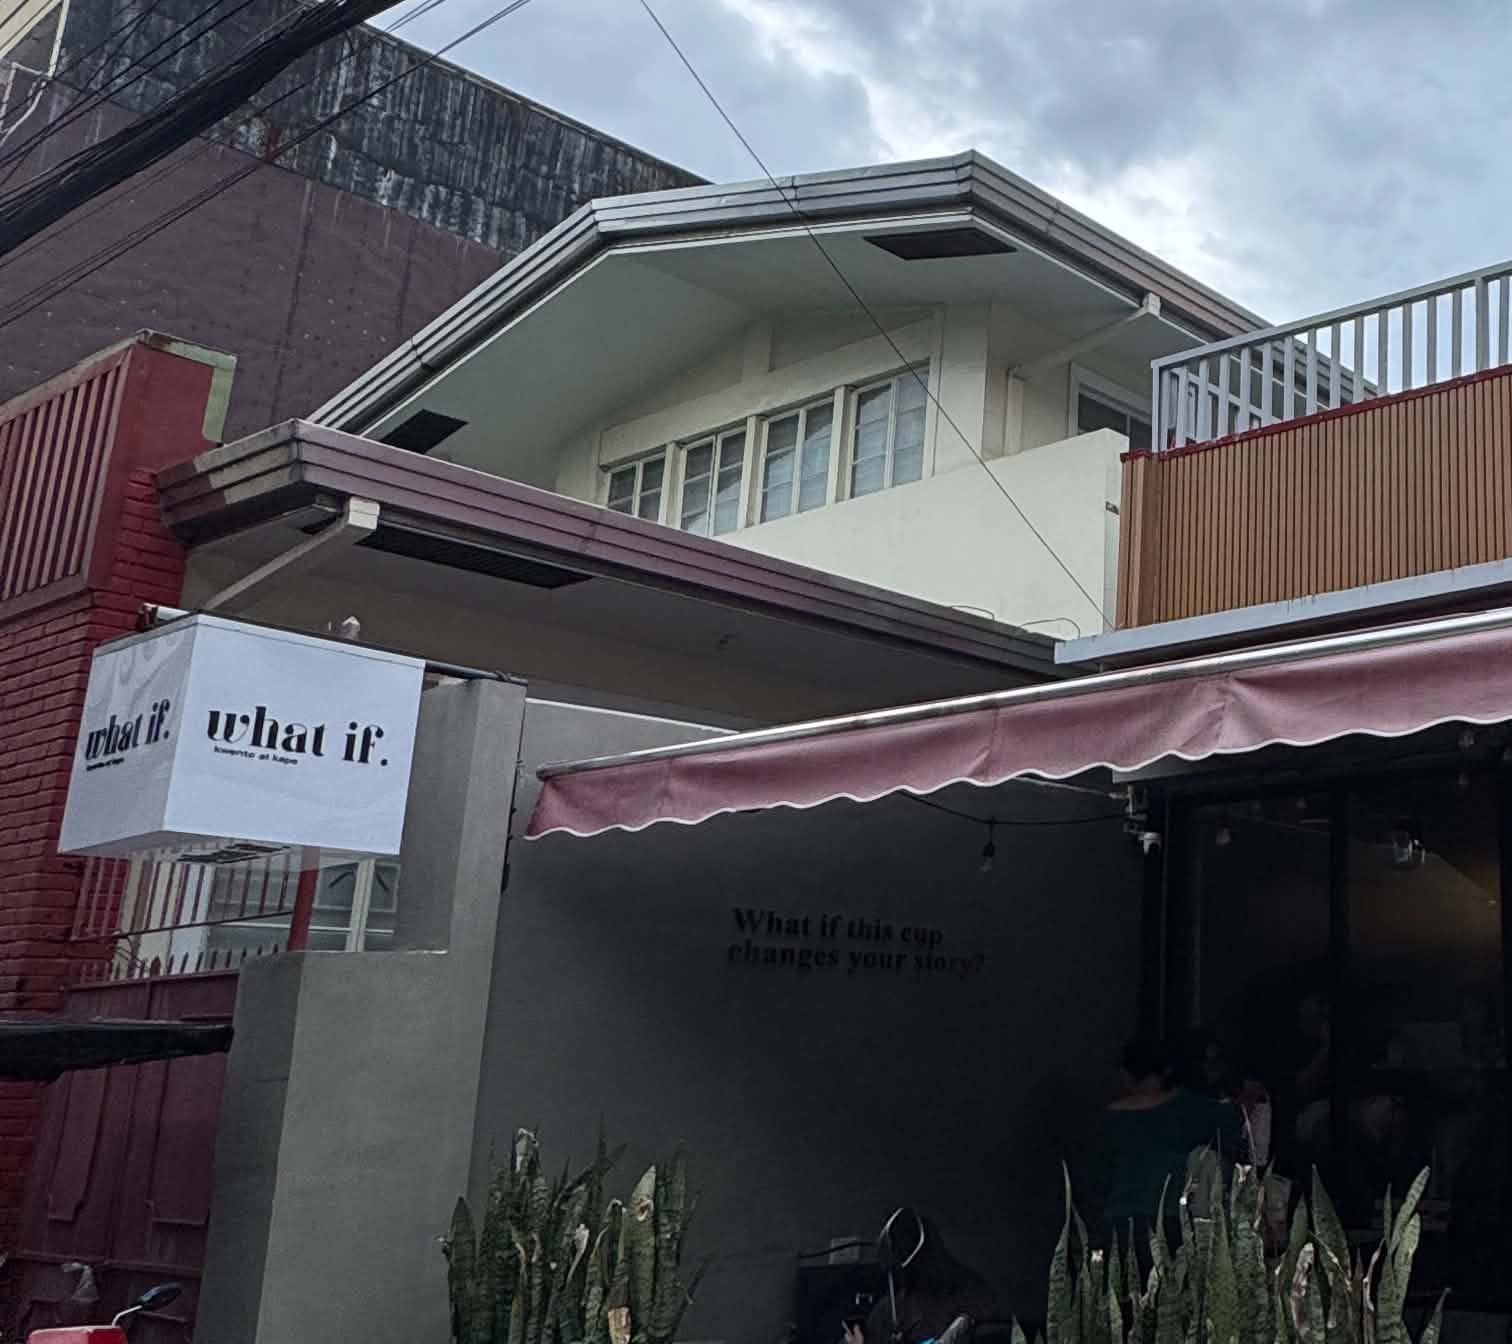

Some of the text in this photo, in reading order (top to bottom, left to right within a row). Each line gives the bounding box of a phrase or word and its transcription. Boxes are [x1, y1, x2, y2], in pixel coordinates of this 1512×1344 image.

[85, 699, 170, 760] what if.
[207, 706, 388, 767] what if.
[732, 906, 944, 950] What if this cup
[727, 939, 840, 970] changes
[847, 949, 907, 975] your
